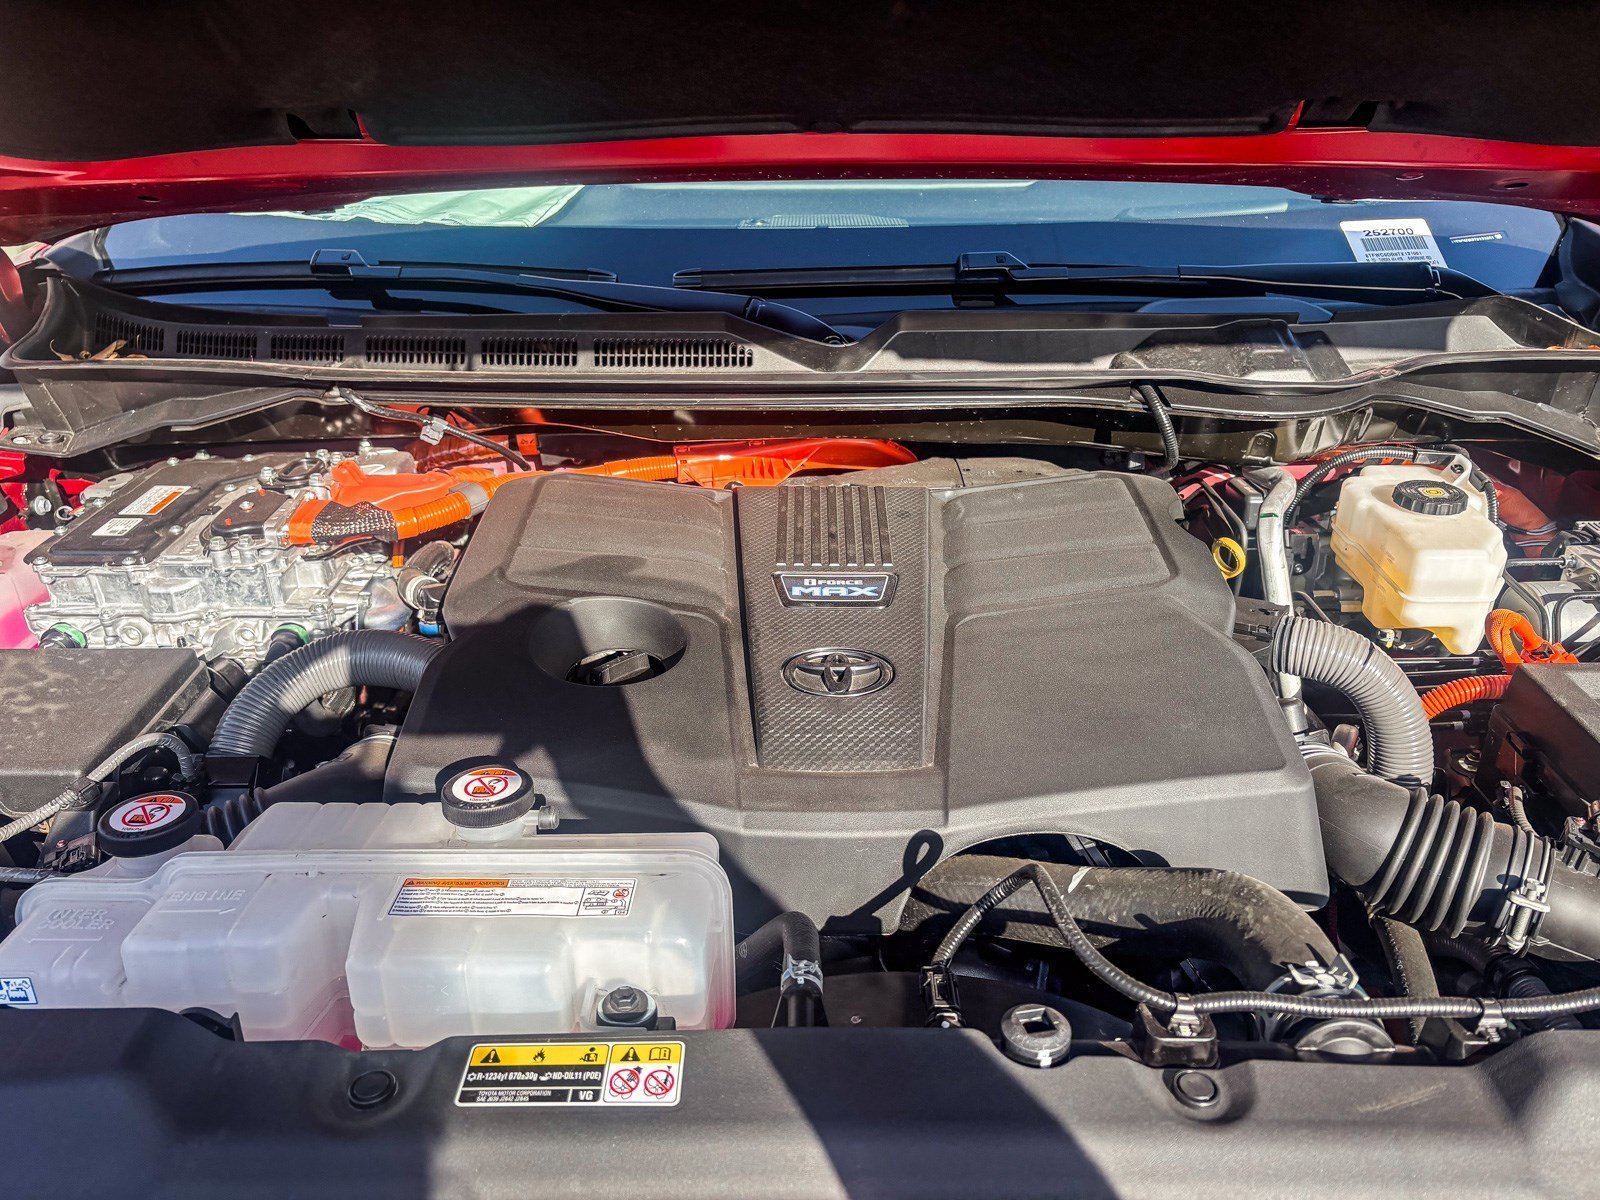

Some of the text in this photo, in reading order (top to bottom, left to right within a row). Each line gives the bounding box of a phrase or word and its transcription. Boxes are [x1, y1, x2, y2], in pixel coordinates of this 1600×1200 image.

[1362, 227, 1414, 237] 252700
[791, 586, 879, 597] MAX
[168, 889, 246, 902] ENGINE
[47, 907, 109, 920] INTER
[37, 919, 115, 930] COOLER
[476, 1071, 508, 1081] R-1234yf
[583, 1071, 602, 1081] (POE)
[579, 1090, 594, 1100] VG
